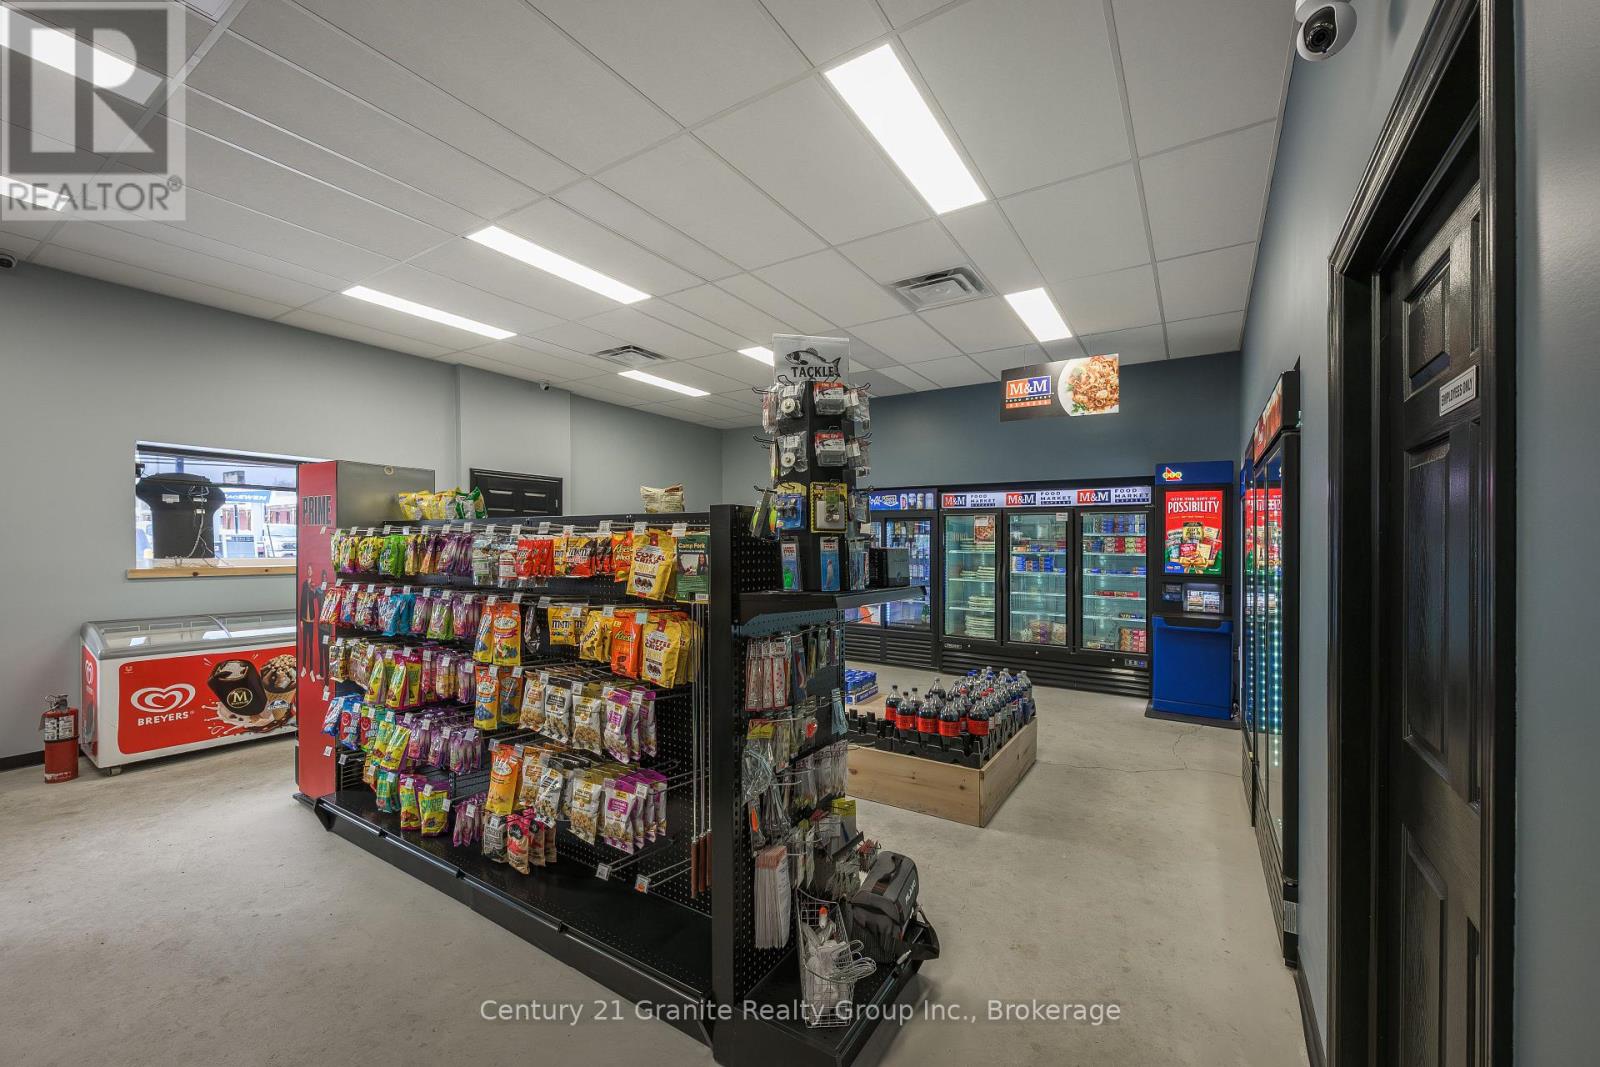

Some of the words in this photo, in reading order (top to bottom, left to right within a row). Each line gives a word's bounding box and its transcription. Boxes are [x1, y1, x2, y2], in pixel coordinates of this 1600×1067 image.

[791, 366, 833, 378] TACKLE
[1009, 379, 1048, 395] M&M
[1441, 384, 1462, 407] EMPLOYEES
[1463, 378, 1472, 394] ONLY
[945, 496, 965, 506] M&M
[1007, 494, 1034, 505] M&M
[1079, 491, 1109, 502] M&M
[302, 496, 332, 527] PRIME
[1168, 500, 1220, 514] POSSIBILITY
[678, 543, 693, 551] Camp
[137, 711, 189, 727] BREYERS
